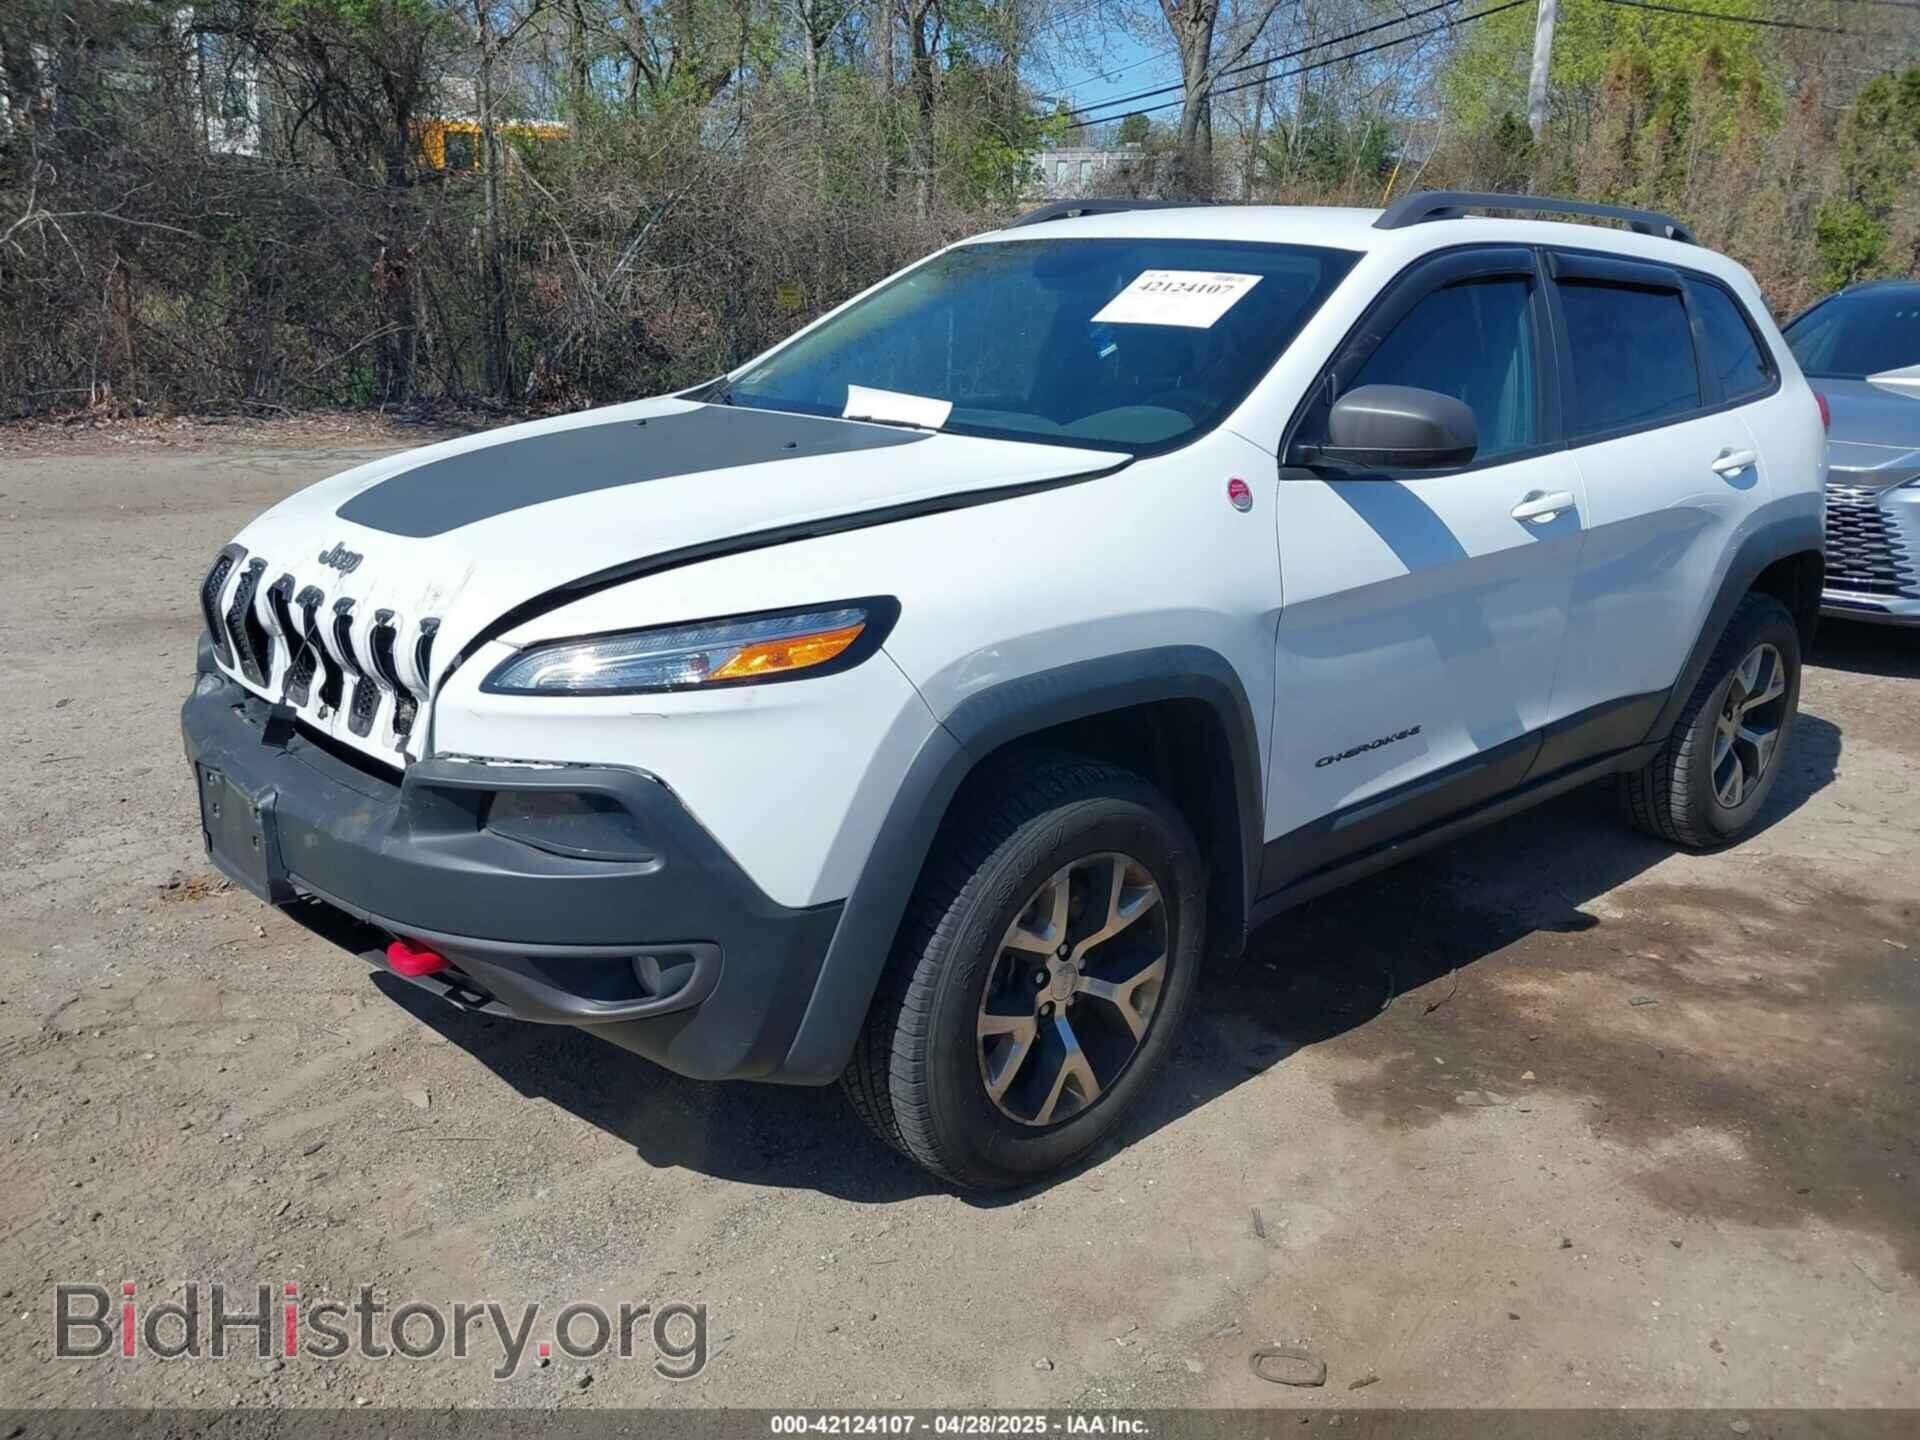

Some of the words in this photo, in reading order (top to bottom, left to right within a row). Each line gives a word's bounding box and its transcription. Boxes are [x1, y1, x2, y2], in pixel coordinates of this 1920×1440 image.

[1138, 281, 1235, 294] 42124107
[318, 541, 364, 577] Jeep
[1315, 724, 1421, 768] CHEROKEE
